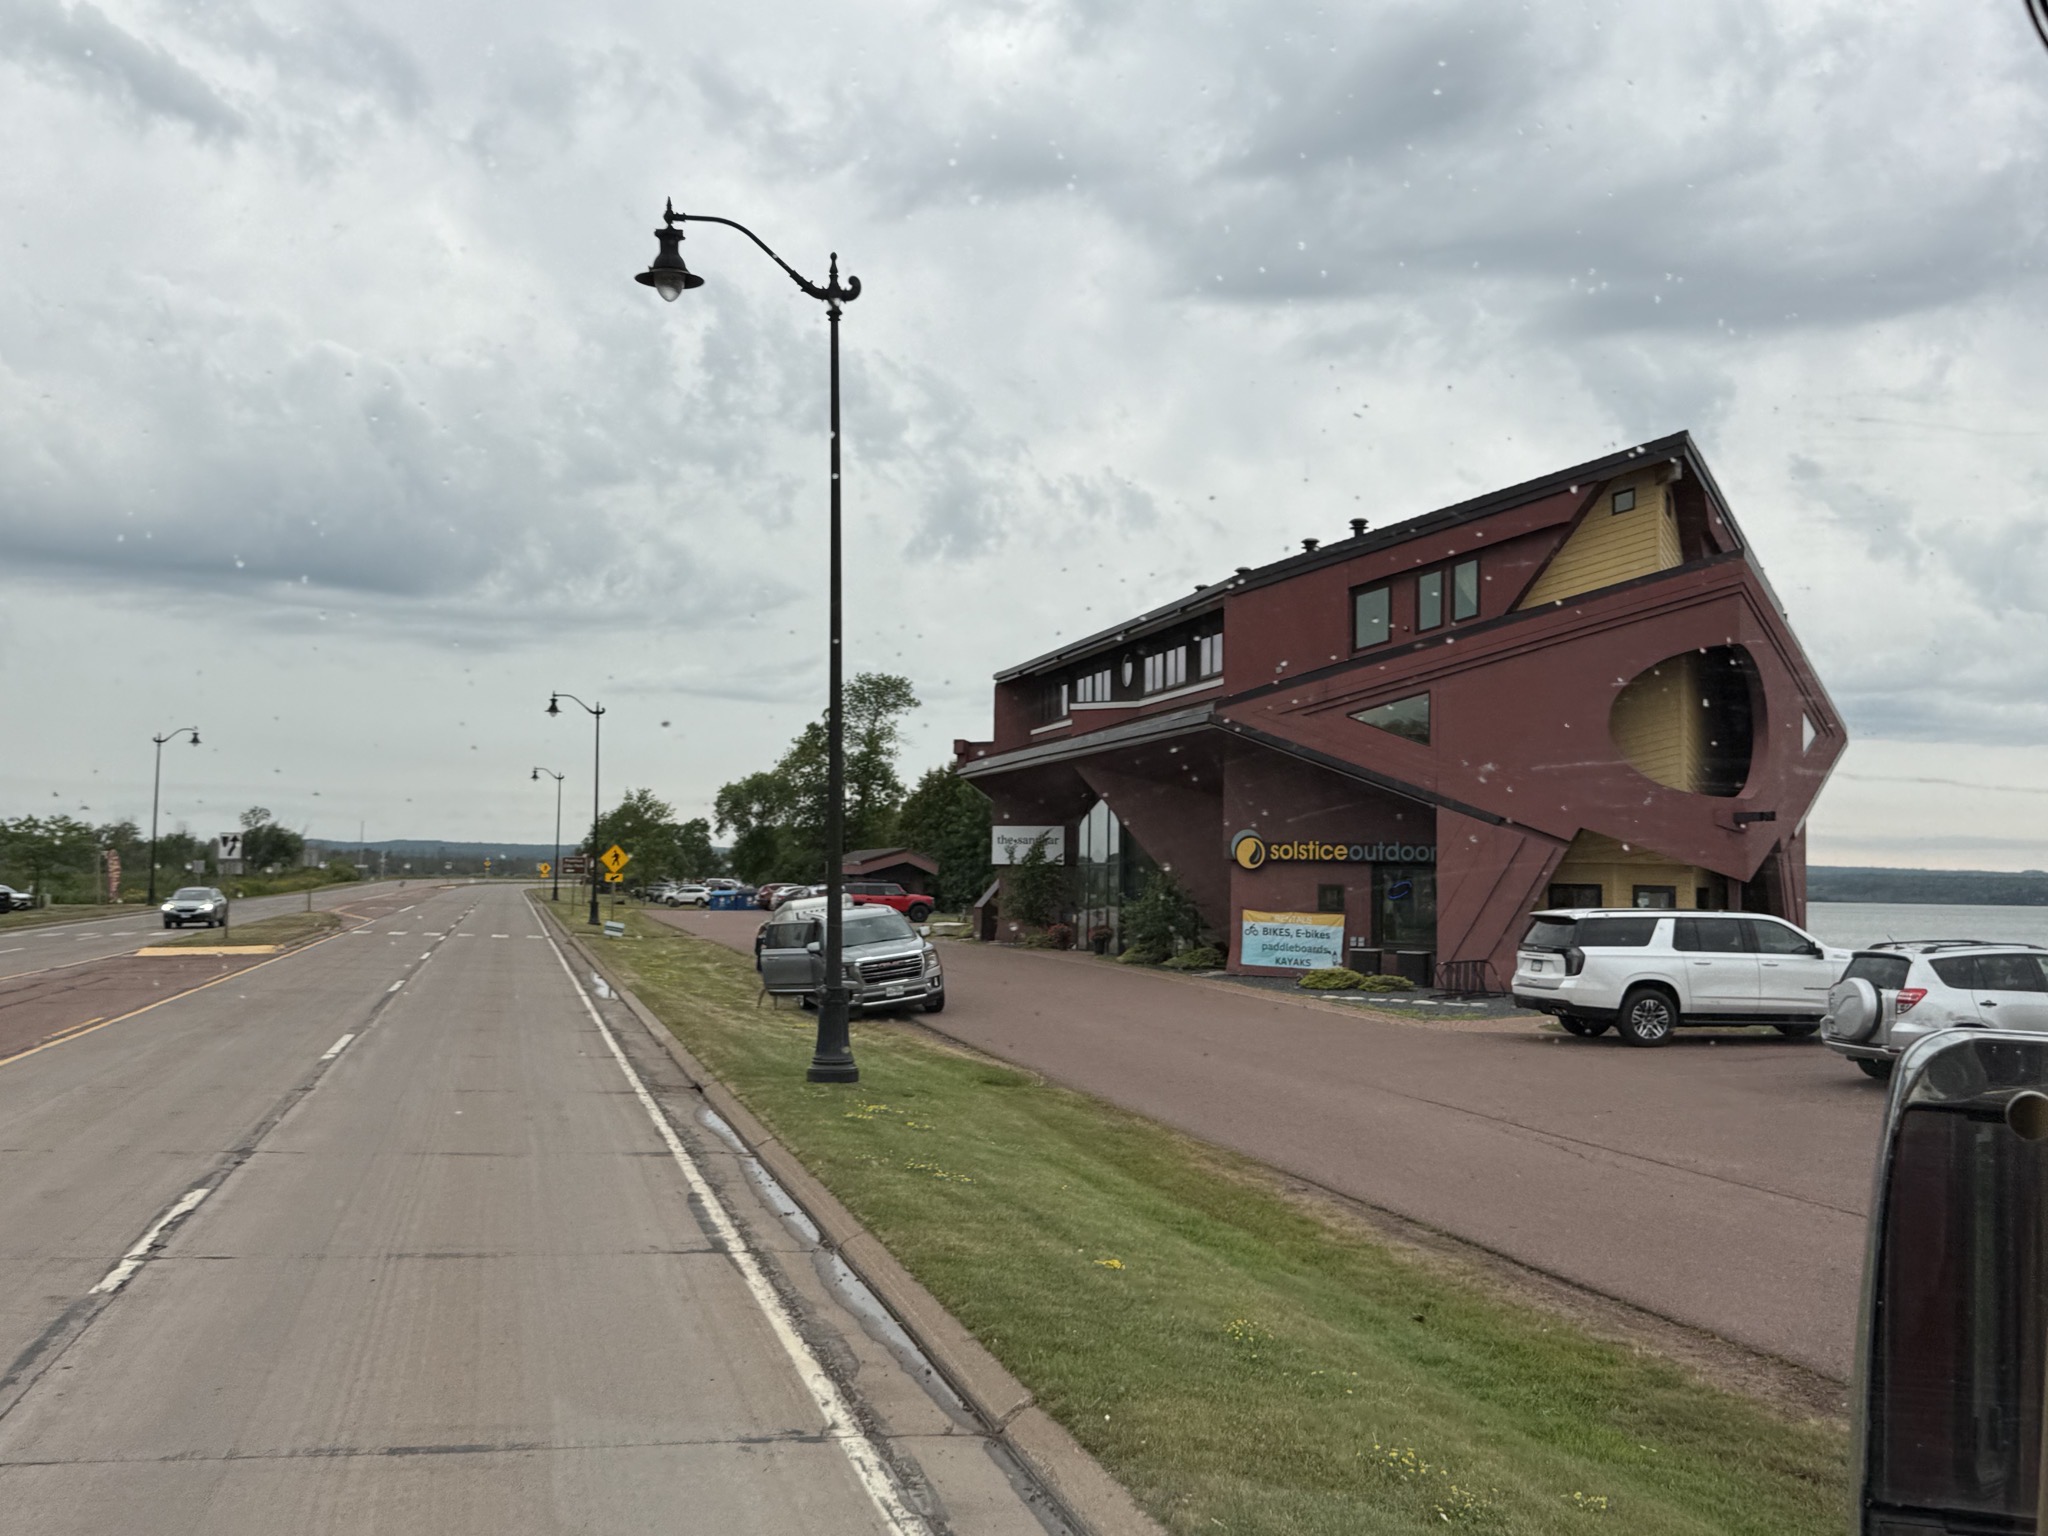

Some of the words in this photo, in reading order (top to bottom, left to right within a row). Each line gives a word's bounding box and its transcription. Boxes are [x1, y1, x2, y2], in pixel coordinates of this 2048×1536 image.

[1262, 927, 1293, 938] BIKES,
[1296, 929, 1330, 939] E-bikes
[1275, 957, 1311, 966] KAYAKS
